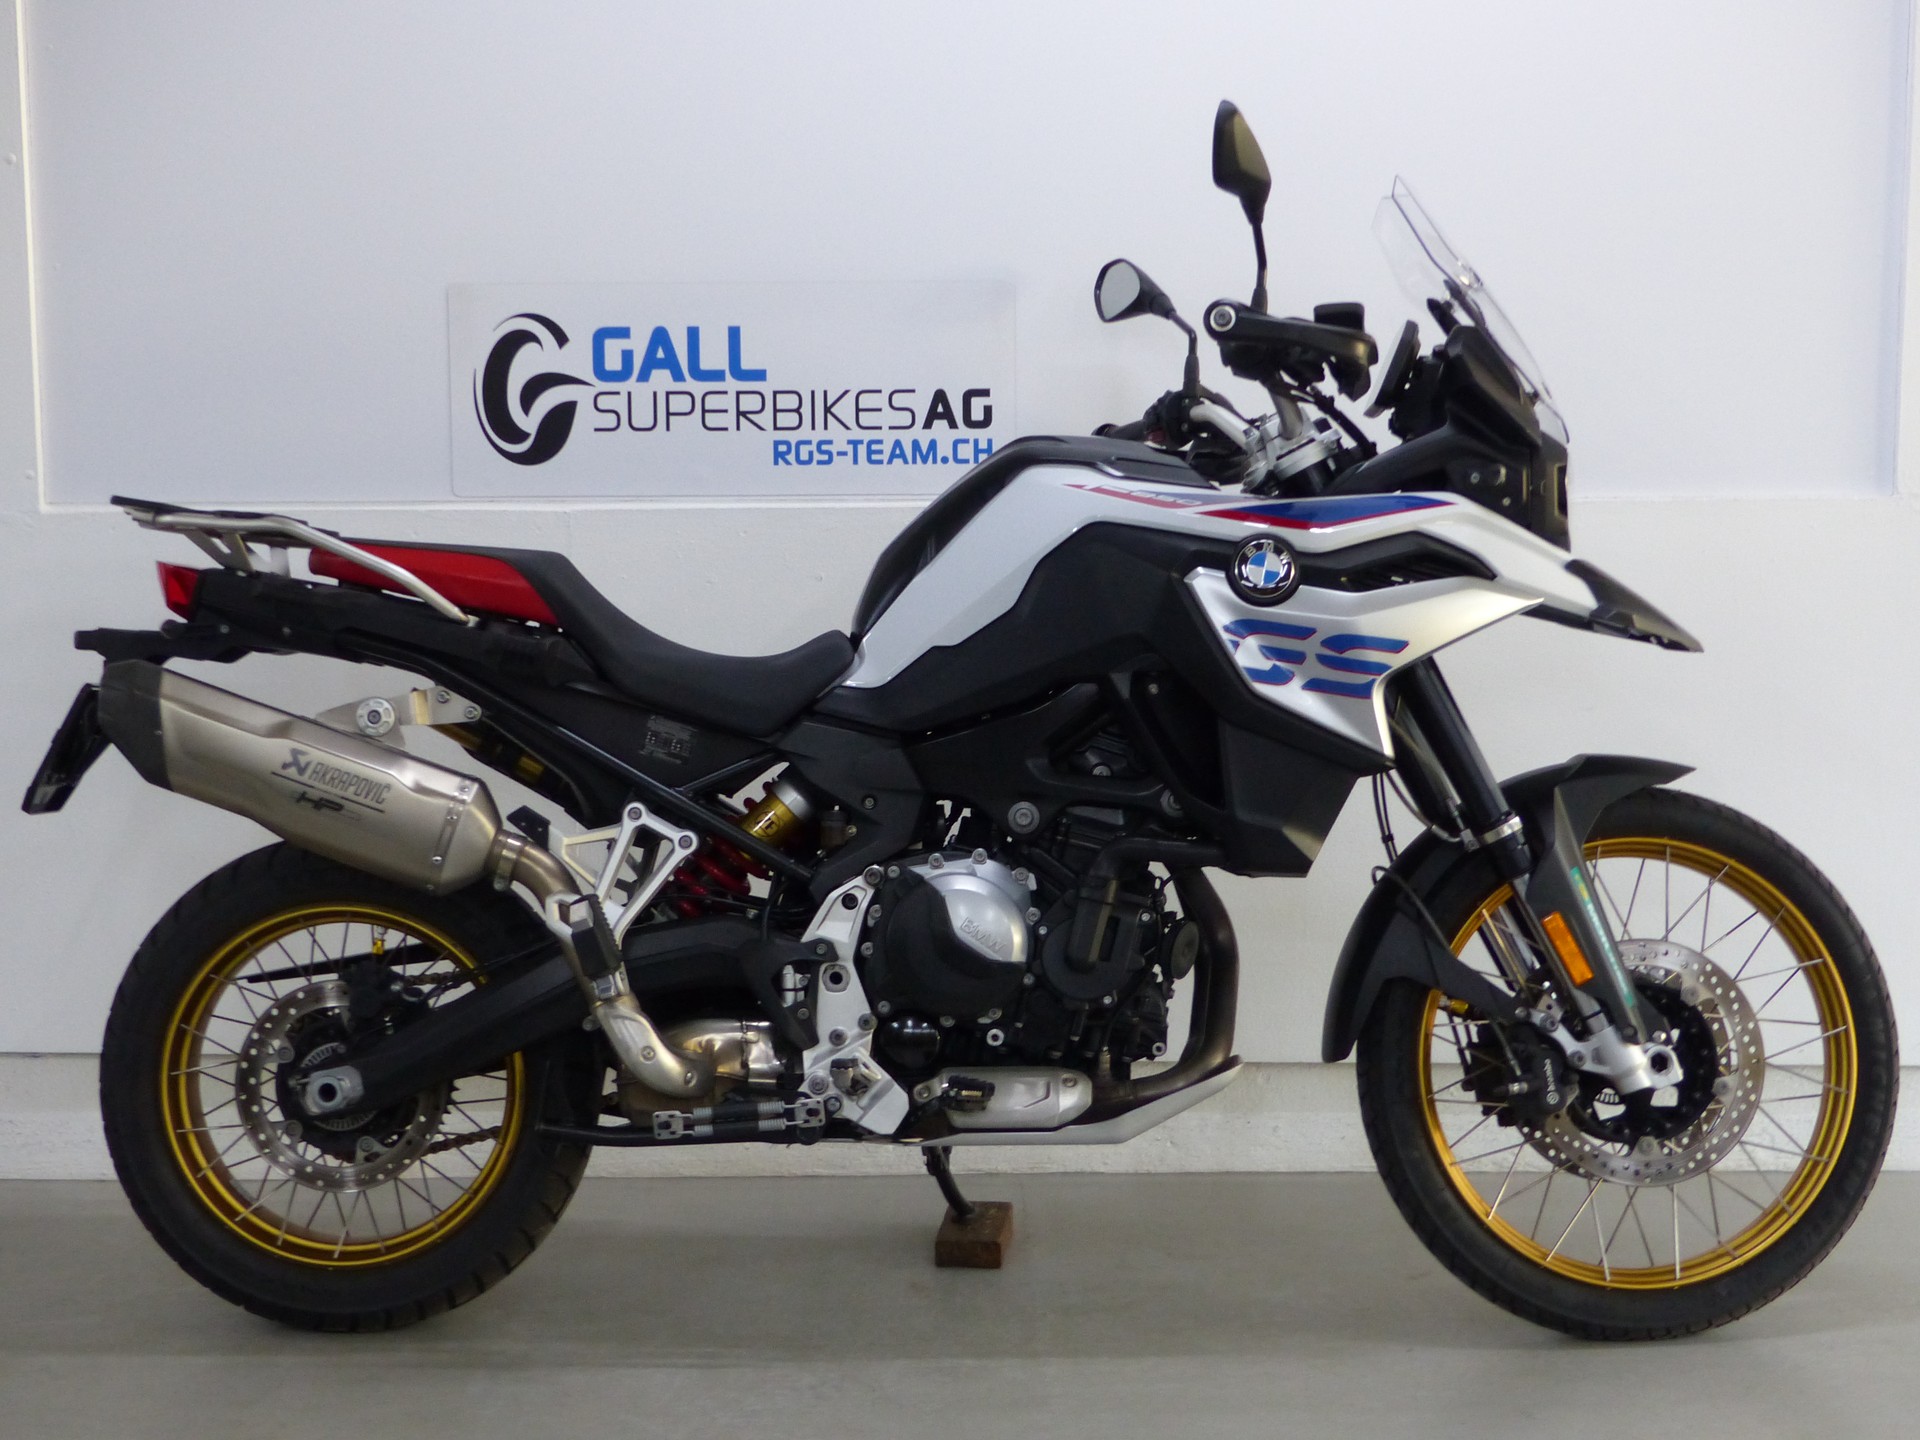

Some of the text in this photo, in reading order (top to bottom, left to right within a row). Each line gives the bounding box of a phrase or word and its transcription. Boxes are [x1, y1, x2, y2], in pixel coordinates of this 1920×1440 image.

[592, 326, 767, 382] GALL
[773, 438, 993, 466] RGS-TEAM.CH
[1244, 541, 1292, 565] BMW
[1223, 618, 1409, 699] GS
[961, 917, 1006, 954] BMW
